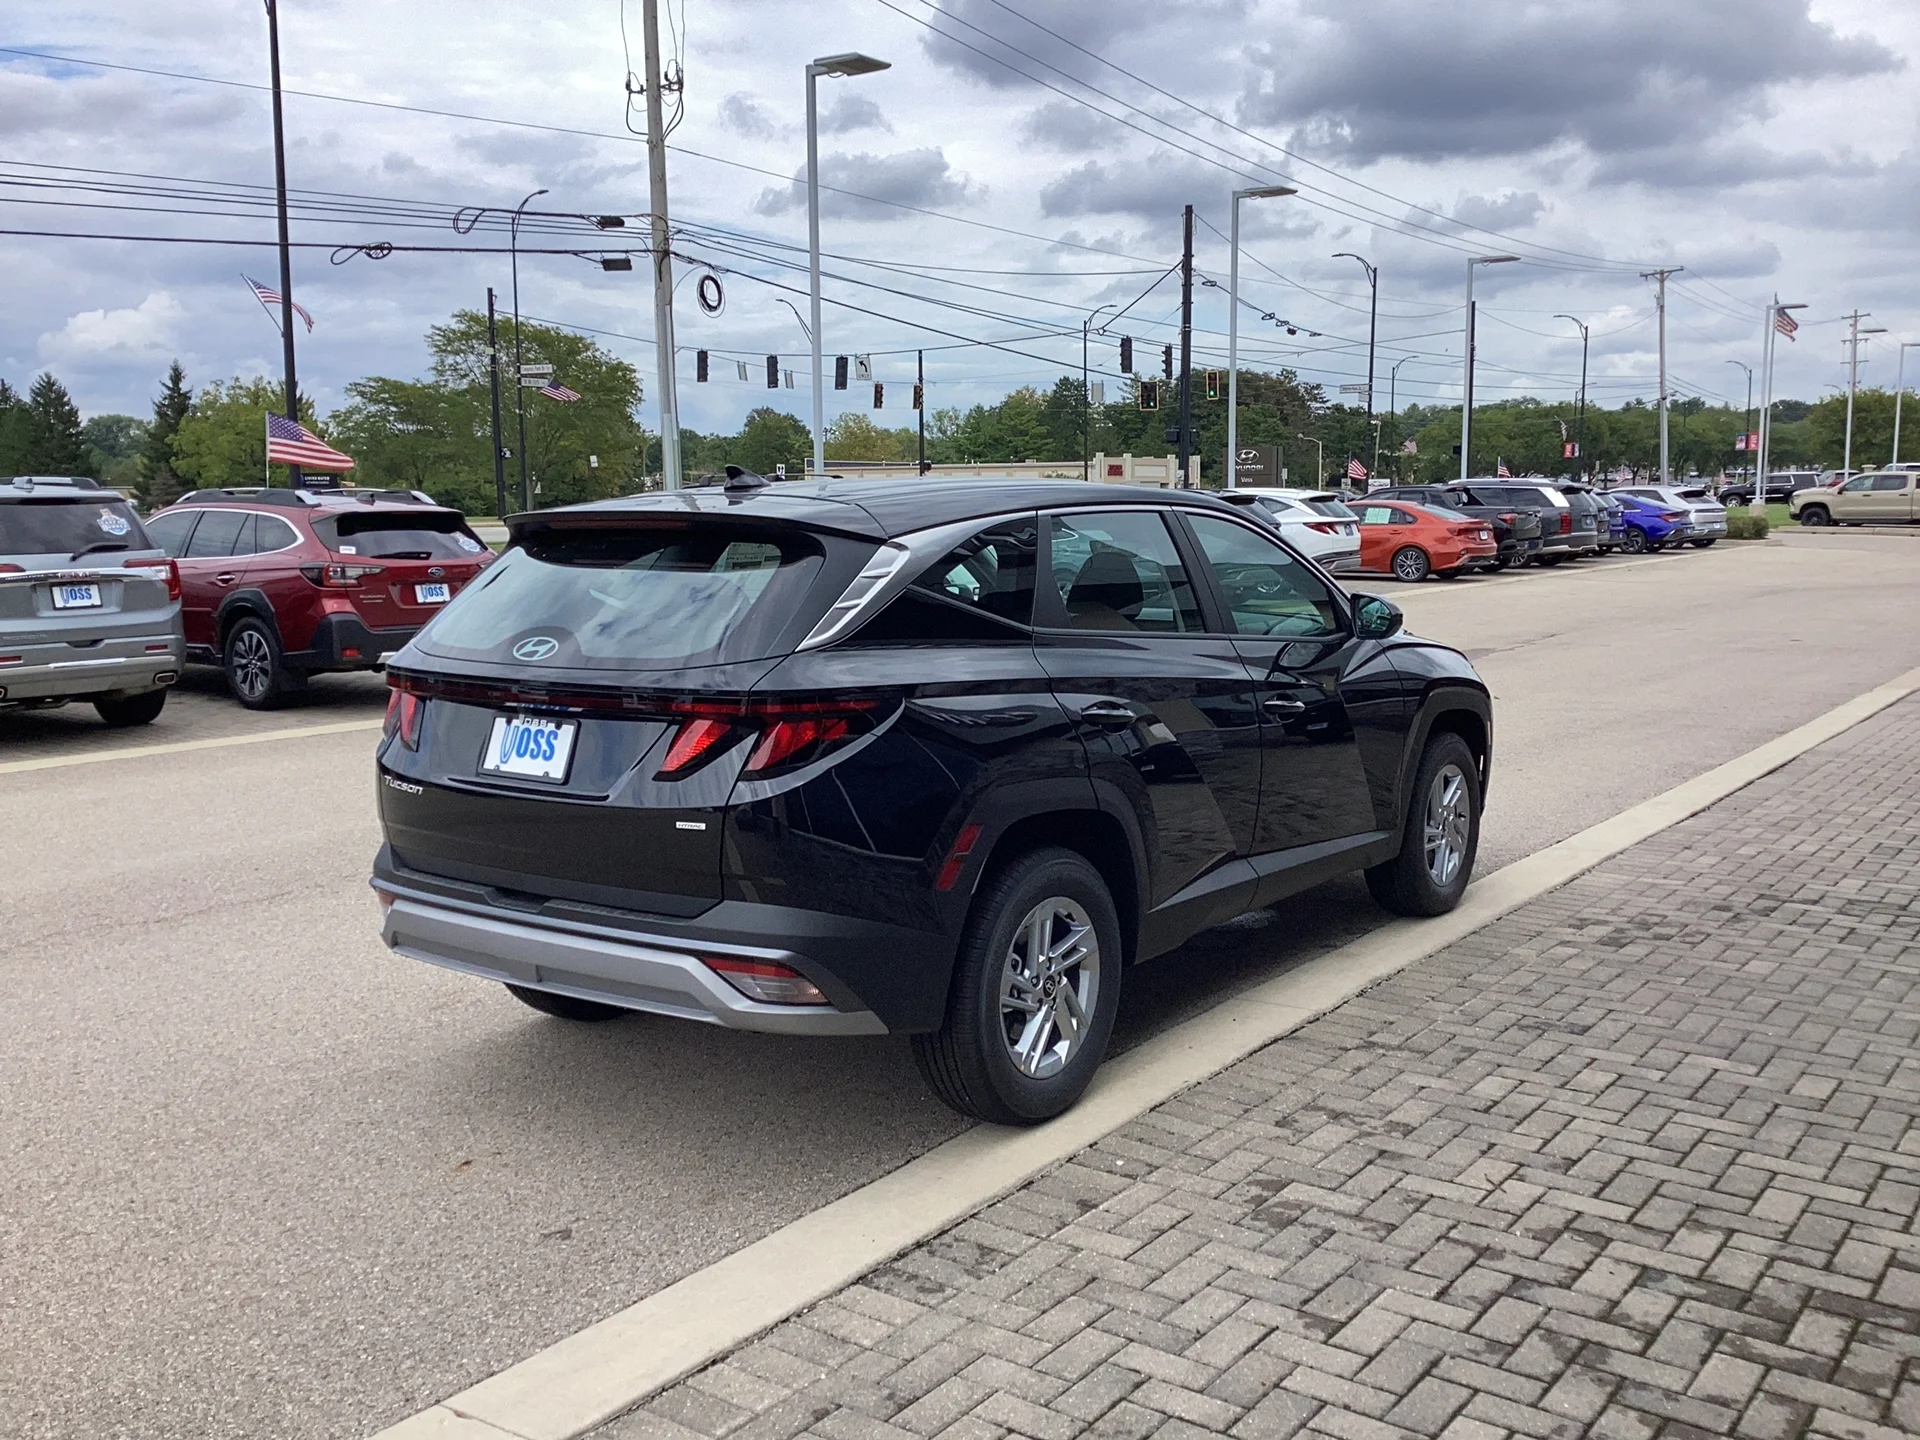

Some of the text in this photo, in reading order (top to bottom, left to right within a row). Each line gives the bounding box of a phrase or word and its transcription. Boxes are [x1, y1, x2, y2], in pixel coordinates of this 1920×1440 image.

[57, 571, 101, 580] GMC
[60, 587, 92, 604] VOSS
[420, 586, 444, 600] VOSS
[499, 724, 560, 765] VOSS
